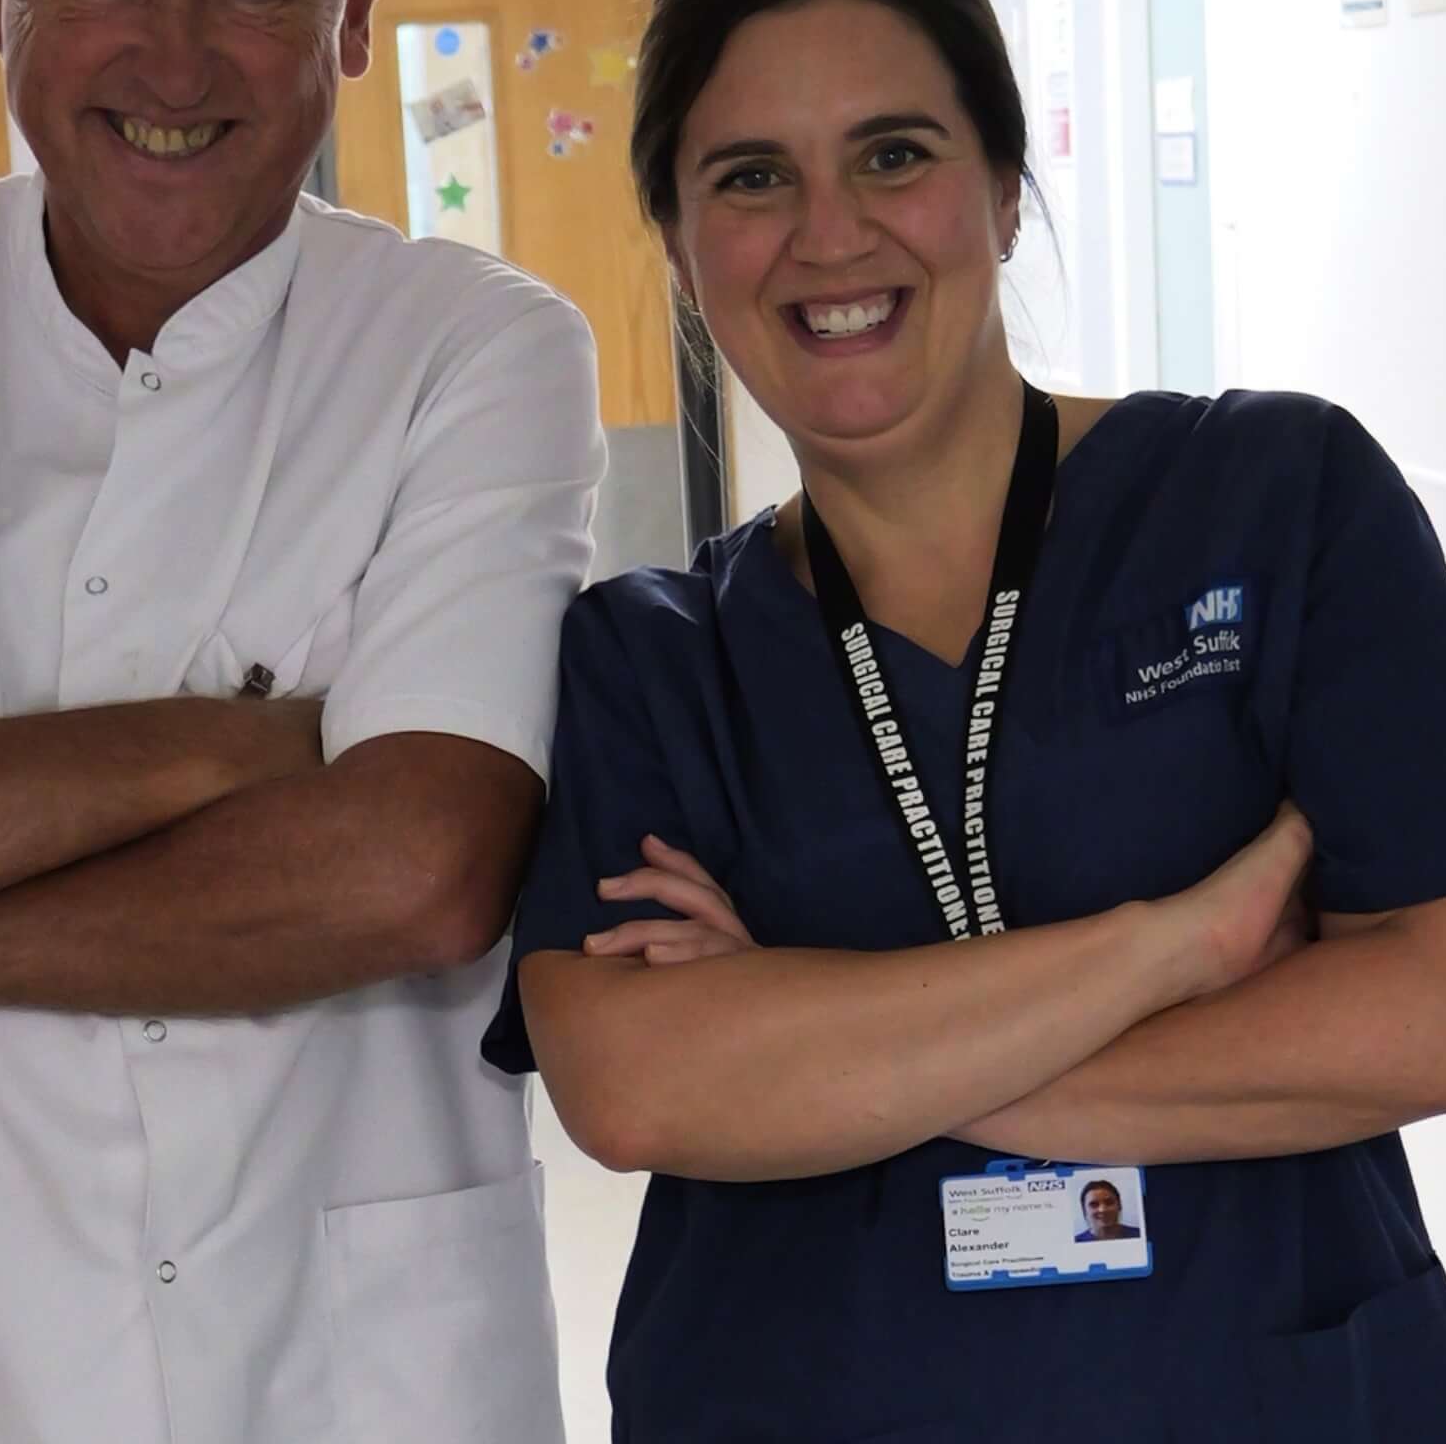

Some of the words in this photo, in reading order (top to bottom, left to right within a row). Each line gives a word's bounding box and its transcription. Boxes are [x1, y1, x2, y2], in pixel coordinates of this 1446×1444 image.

[974, 589, 1020, 698] SURGICAL
[1137, 648, 1190, 684] West
[840, 621, 892, 721] SURGICAL
[871, 719, 914, 776] CARE
[1125, 686, 1157, 705] NHS
[966, 701, 995, 765] CARE
[964, 766, 1006, 937] PRACTITIONE
[948, 1187, 978, 1198] West
[980, 1185, 1022, 1196] Suffolk
[1028, 1179, 1066, 1193] NHS
[948, 1227, 980, 1237] Clare
[949, 1241, 1010, 1253] Alexander
